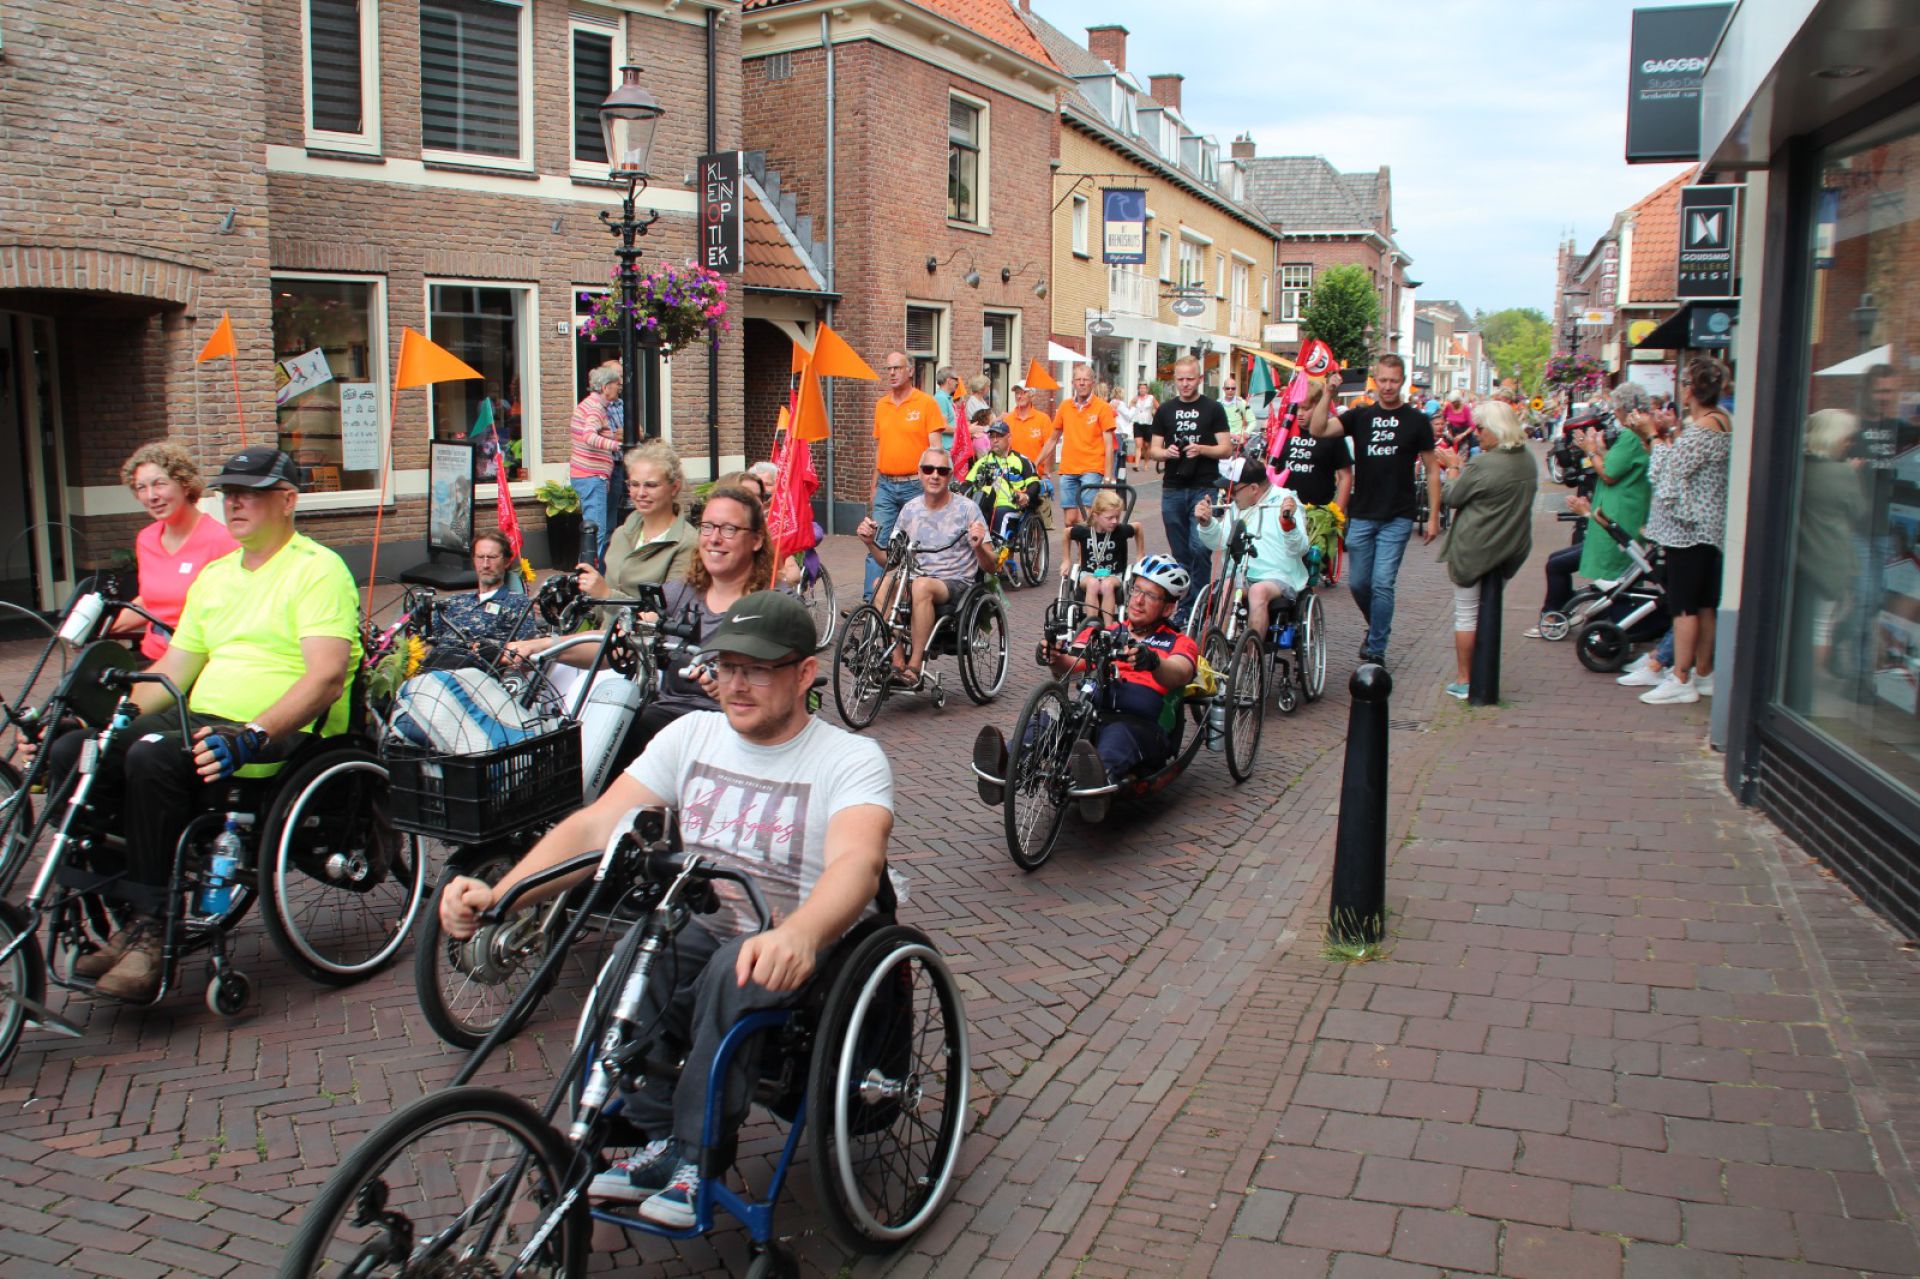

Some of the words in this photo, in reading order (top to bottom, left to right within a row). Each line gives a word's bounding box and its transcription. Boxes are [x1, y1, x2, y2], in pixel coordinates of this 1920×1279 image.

[1175, 409, 1200, 420] Rob
[1176, 420, 1197, 431] 25e
[1371, 416, 1399, 428] Rob
[1290, 436, 1317, 447] Rob
[1371, 430, 1396, 442] 25e
[1289, 447, 1312, 459] 25e
[1367, 444, 1399, 456] Keer
[1285, 460, 1316, 473] Keer
